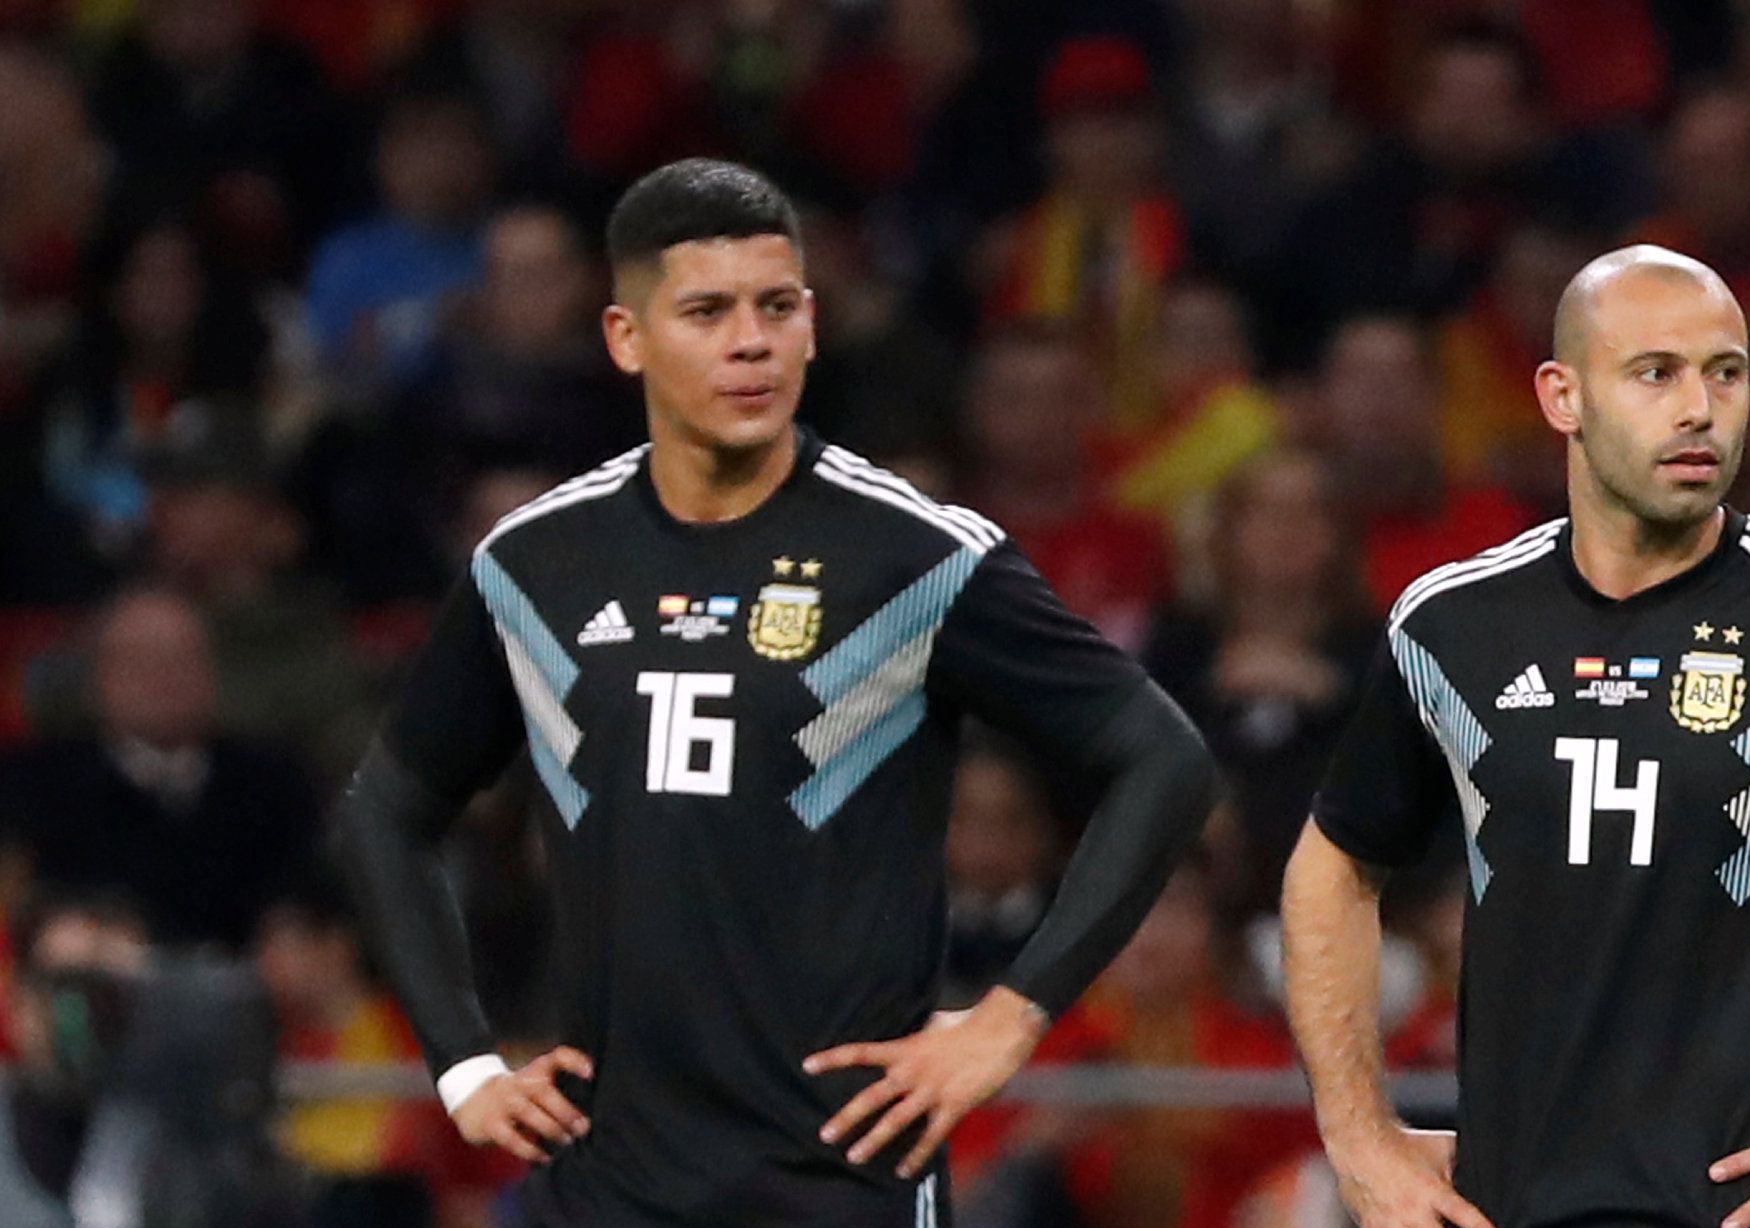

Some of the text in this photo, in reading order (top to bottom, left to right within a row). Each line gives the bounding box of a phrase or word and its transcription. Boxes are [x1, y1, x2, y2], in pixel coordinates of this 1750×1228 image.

[636, 671, 736, 796] 16
[1495, 691, 1555, 710] adidas
[1554, 737, 1660, 866] 14
